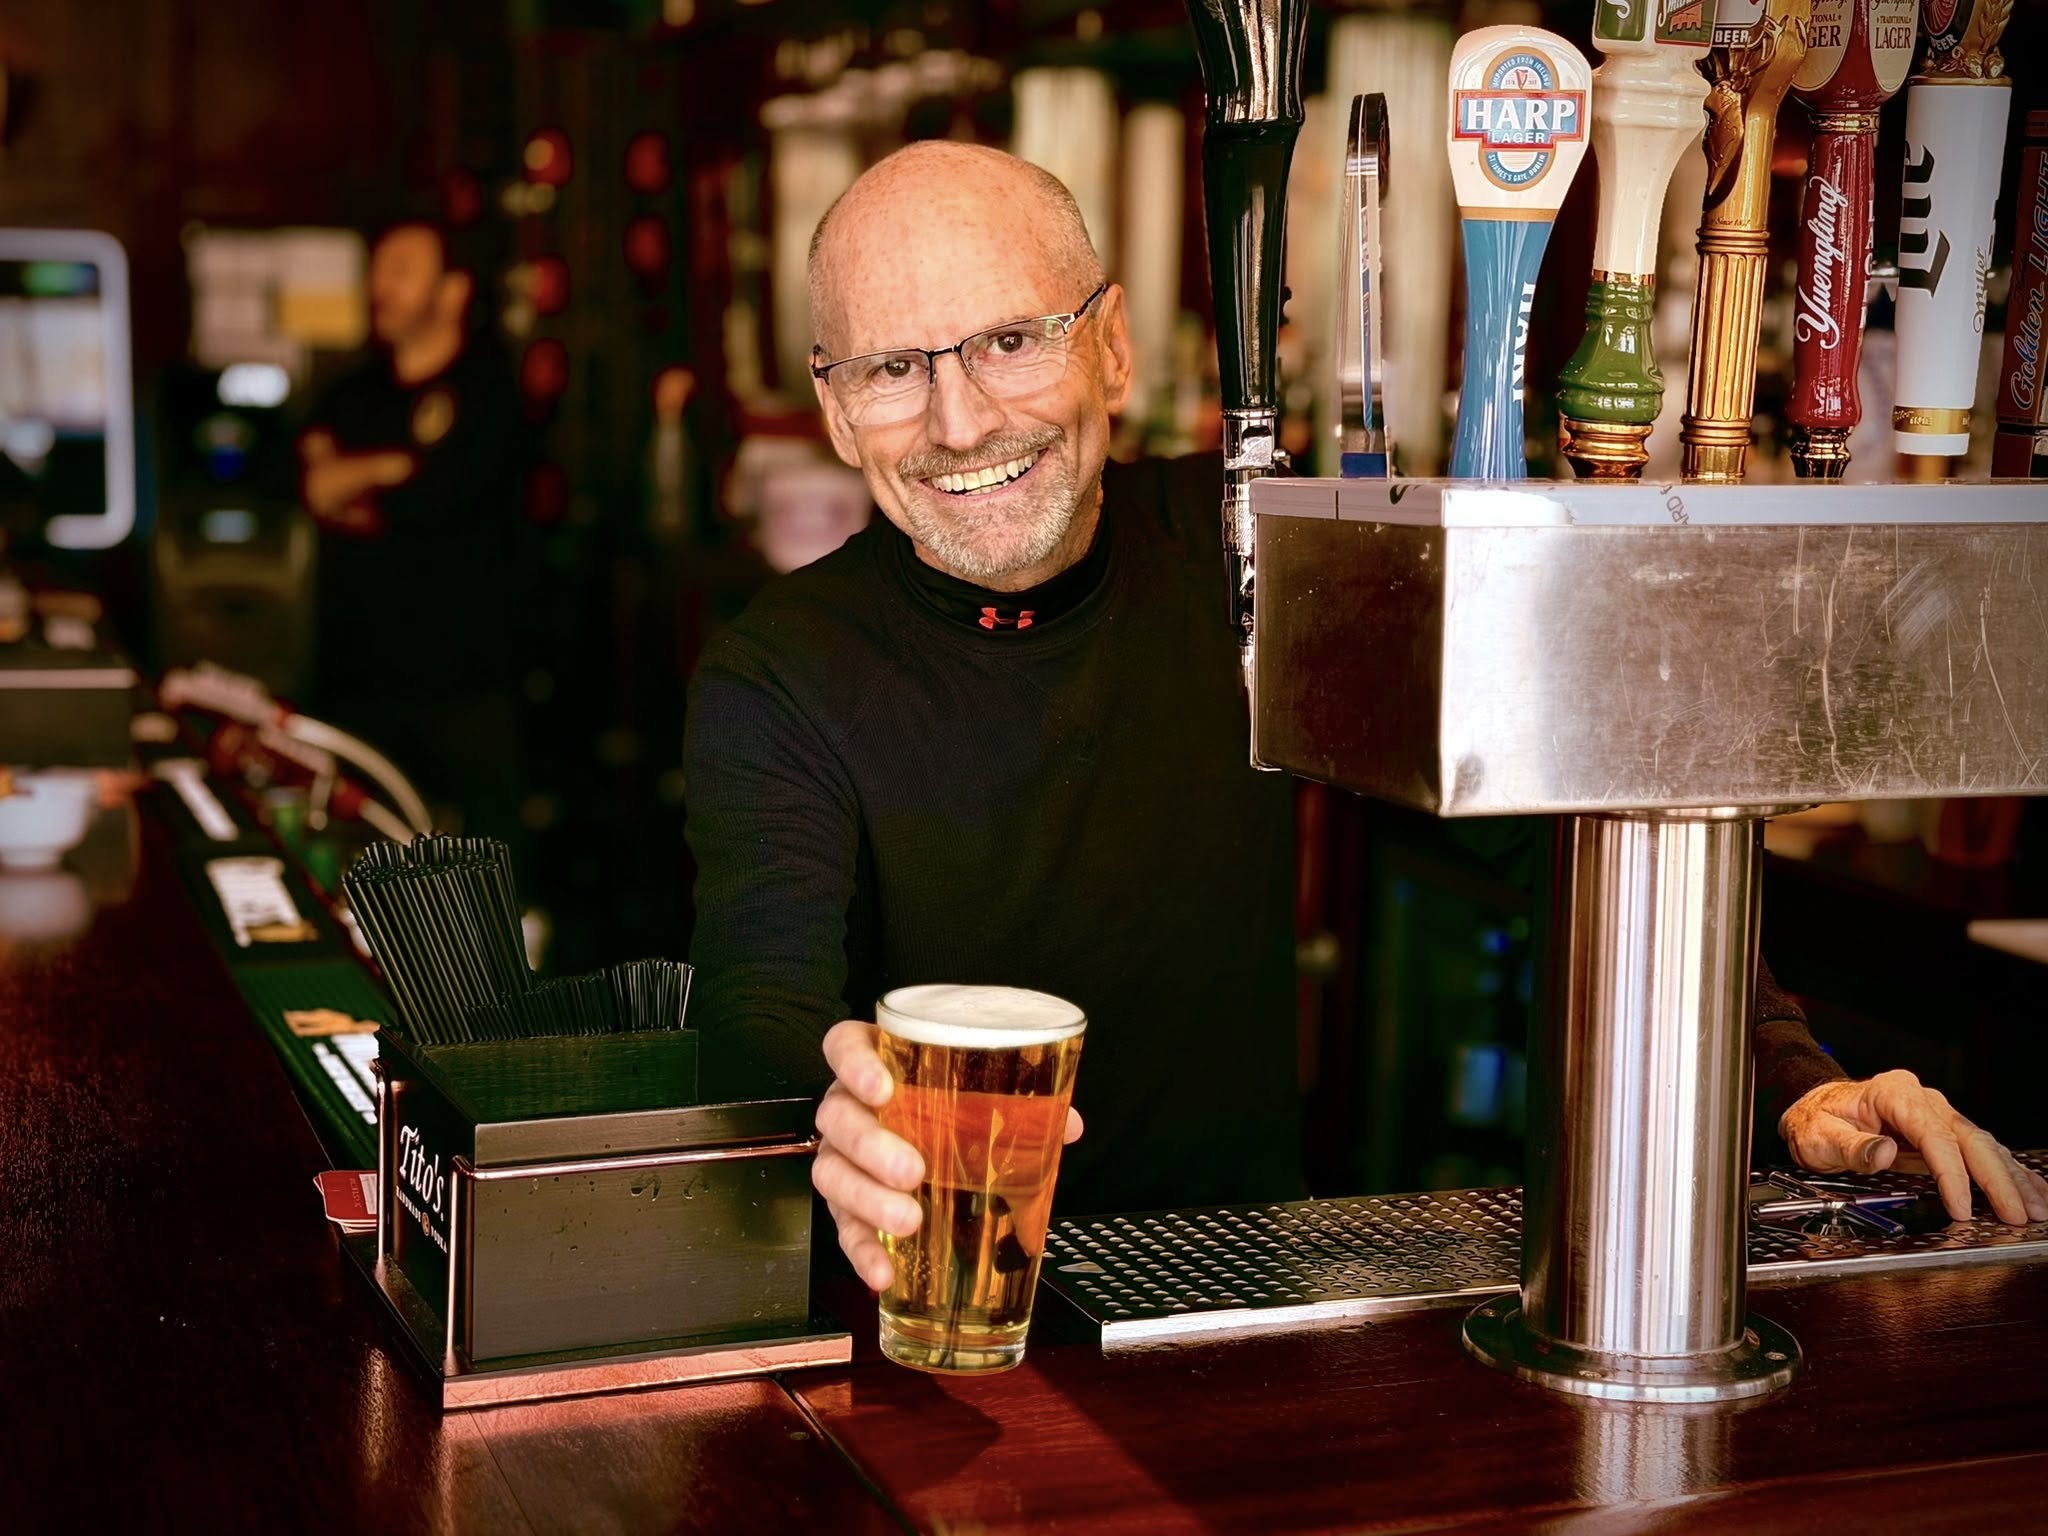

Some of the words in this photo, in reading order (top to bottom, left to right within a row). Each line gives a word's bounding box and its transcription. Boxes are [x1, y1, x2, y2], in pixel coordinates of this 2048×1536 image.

[1811, 13, 1837, 23] TIONAL
[1714, 29, 1750, 43] BEER
[1807, 25, 1841, 48] GER
[1875, 27, 1911, 49] LAGER
[1492, 58, 1516, 88] IMPORTED
[1516, 56, 1534, 66] FROM
[1533, 61, 1551, 87] IRELAND
[1466, 99, 1576, 130] HARP
[1491, 132, 1545, 143] LAGER
[1528, 154, 1546, 177] DUBLIN
[1795, 175, 1848, 350] Yuengling
[2011, 281, 2046, 411] Golden
[395, 1184, 422, 1223] HANDMADE
[431, 1225, 448, 1254] VODKA
